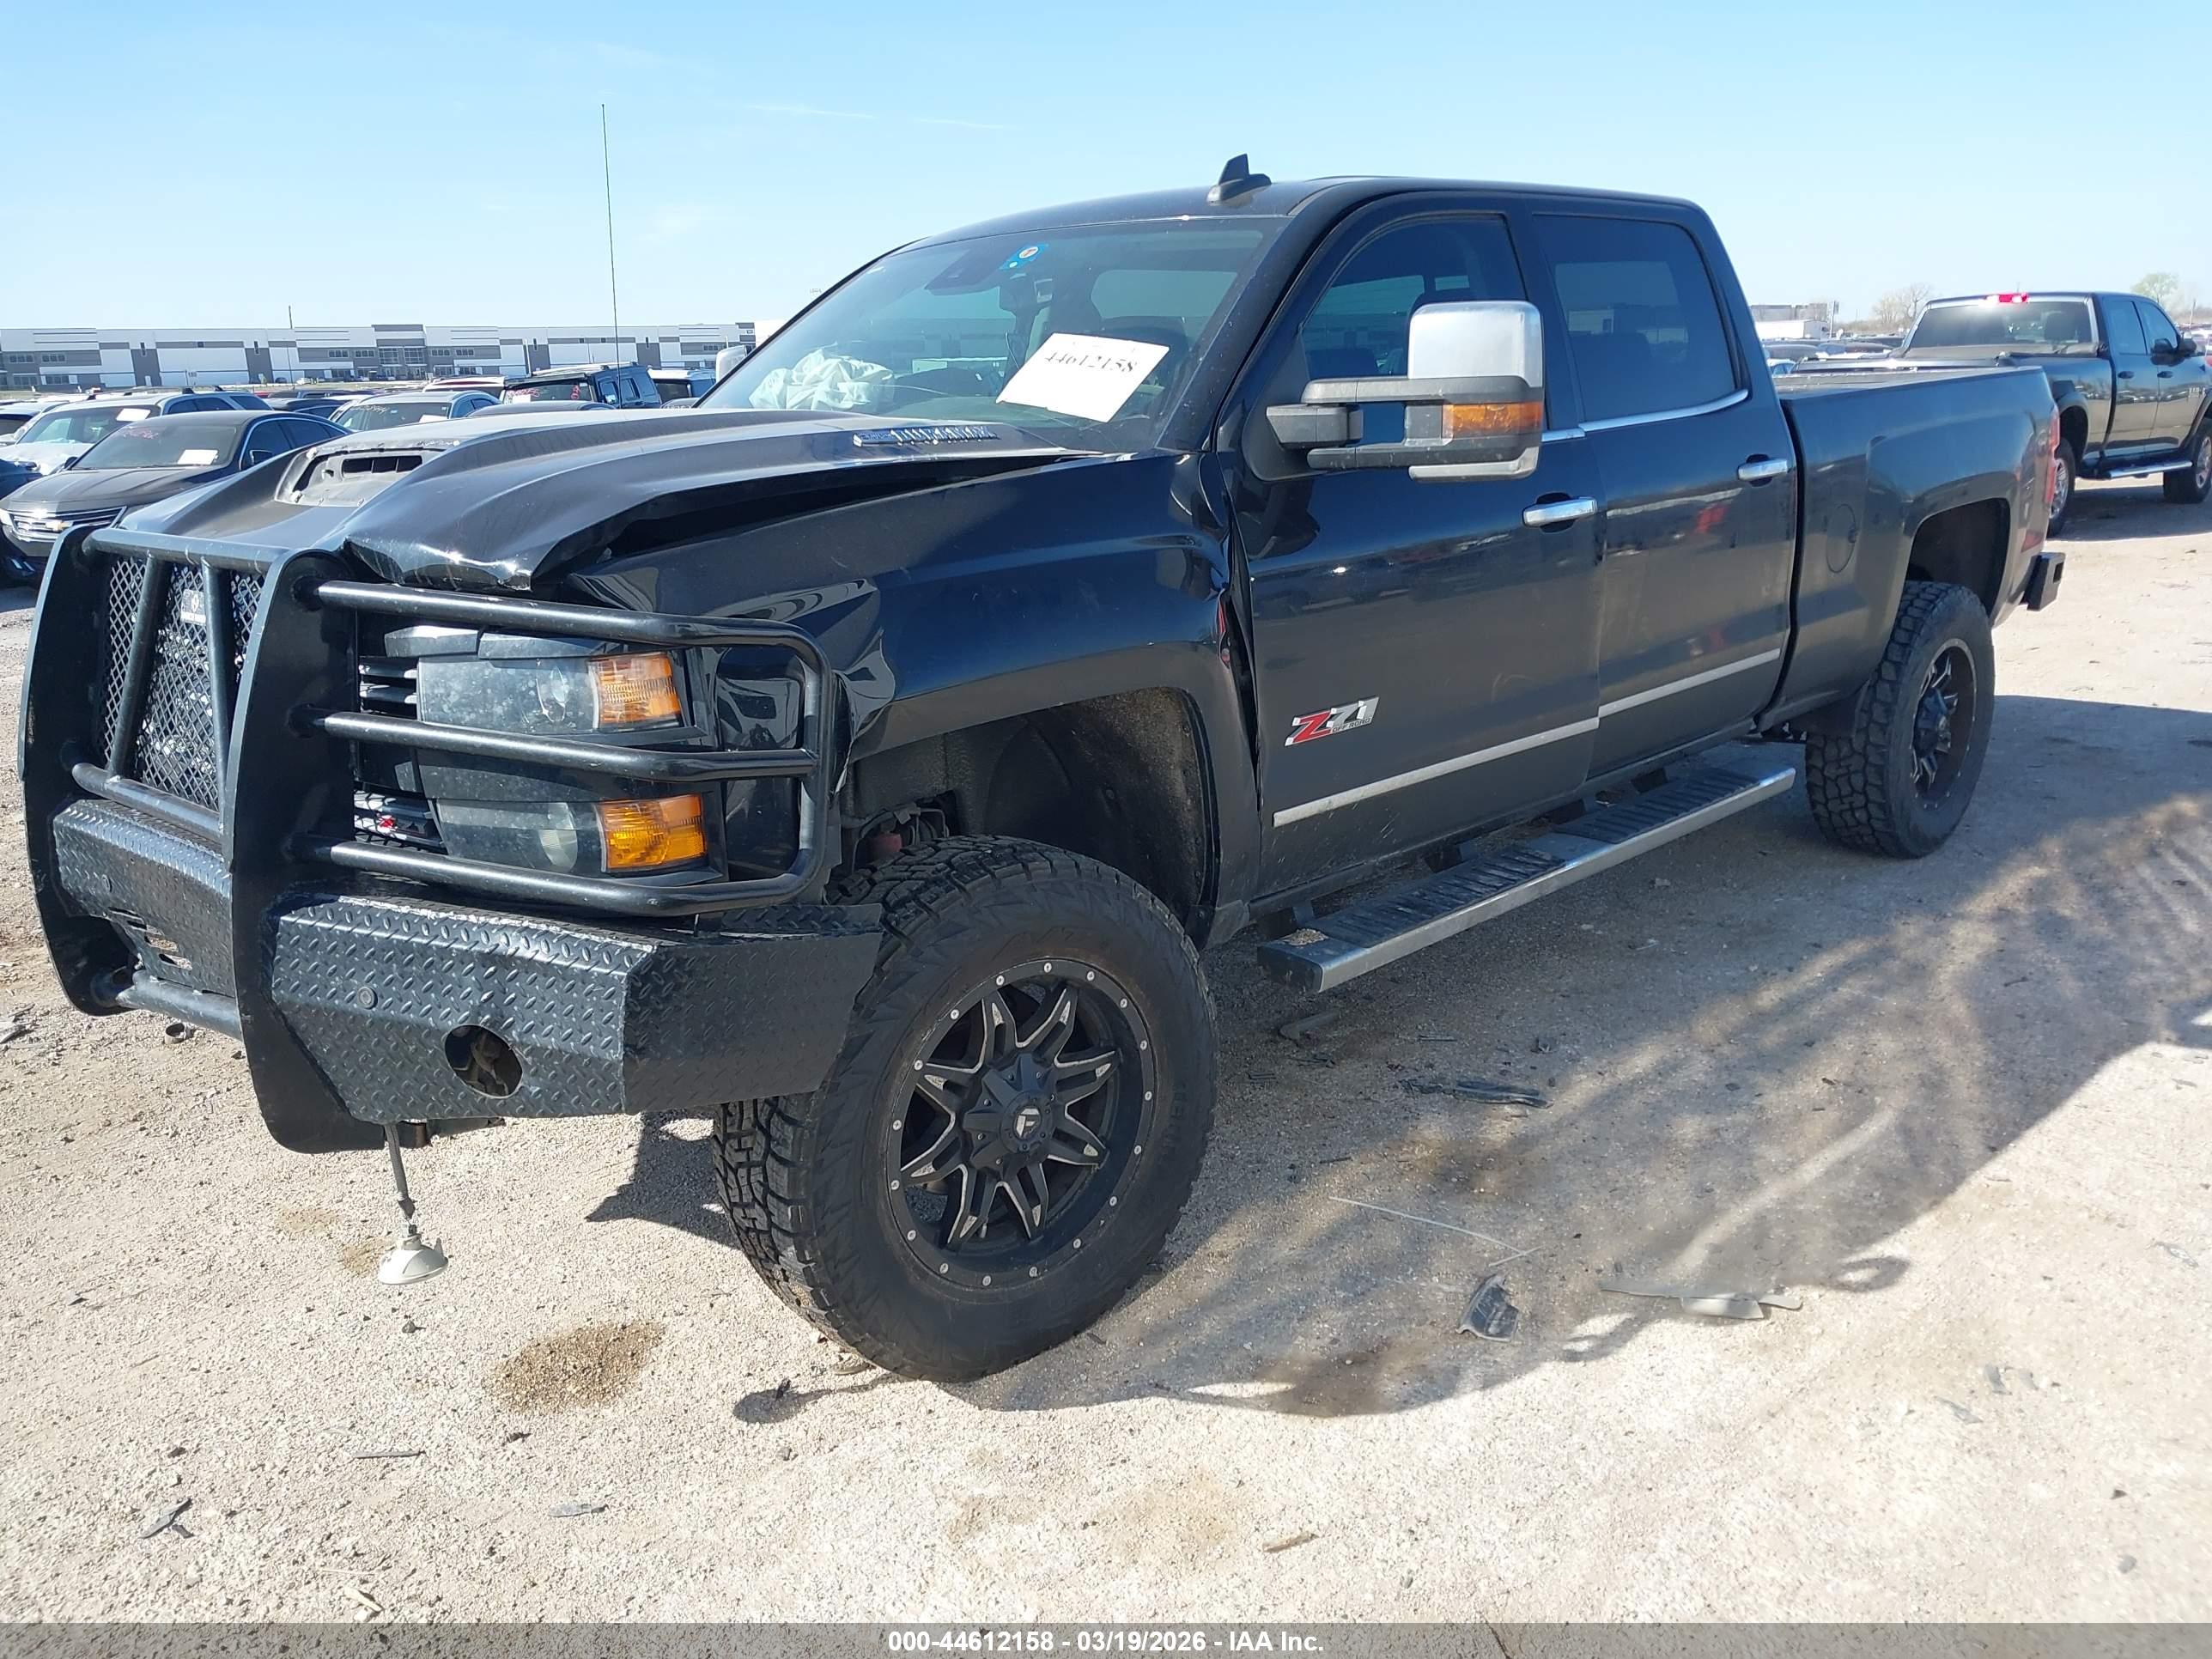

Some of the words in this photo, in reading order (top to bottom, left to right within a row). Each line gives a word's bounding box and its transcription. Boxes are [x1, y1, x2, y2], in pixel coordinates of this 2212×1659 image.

[1285, 696, 1380, 746] Z71
[1332, 724, 1348, 732] OFF
[1348, 717, 1372, 729] ROAD
